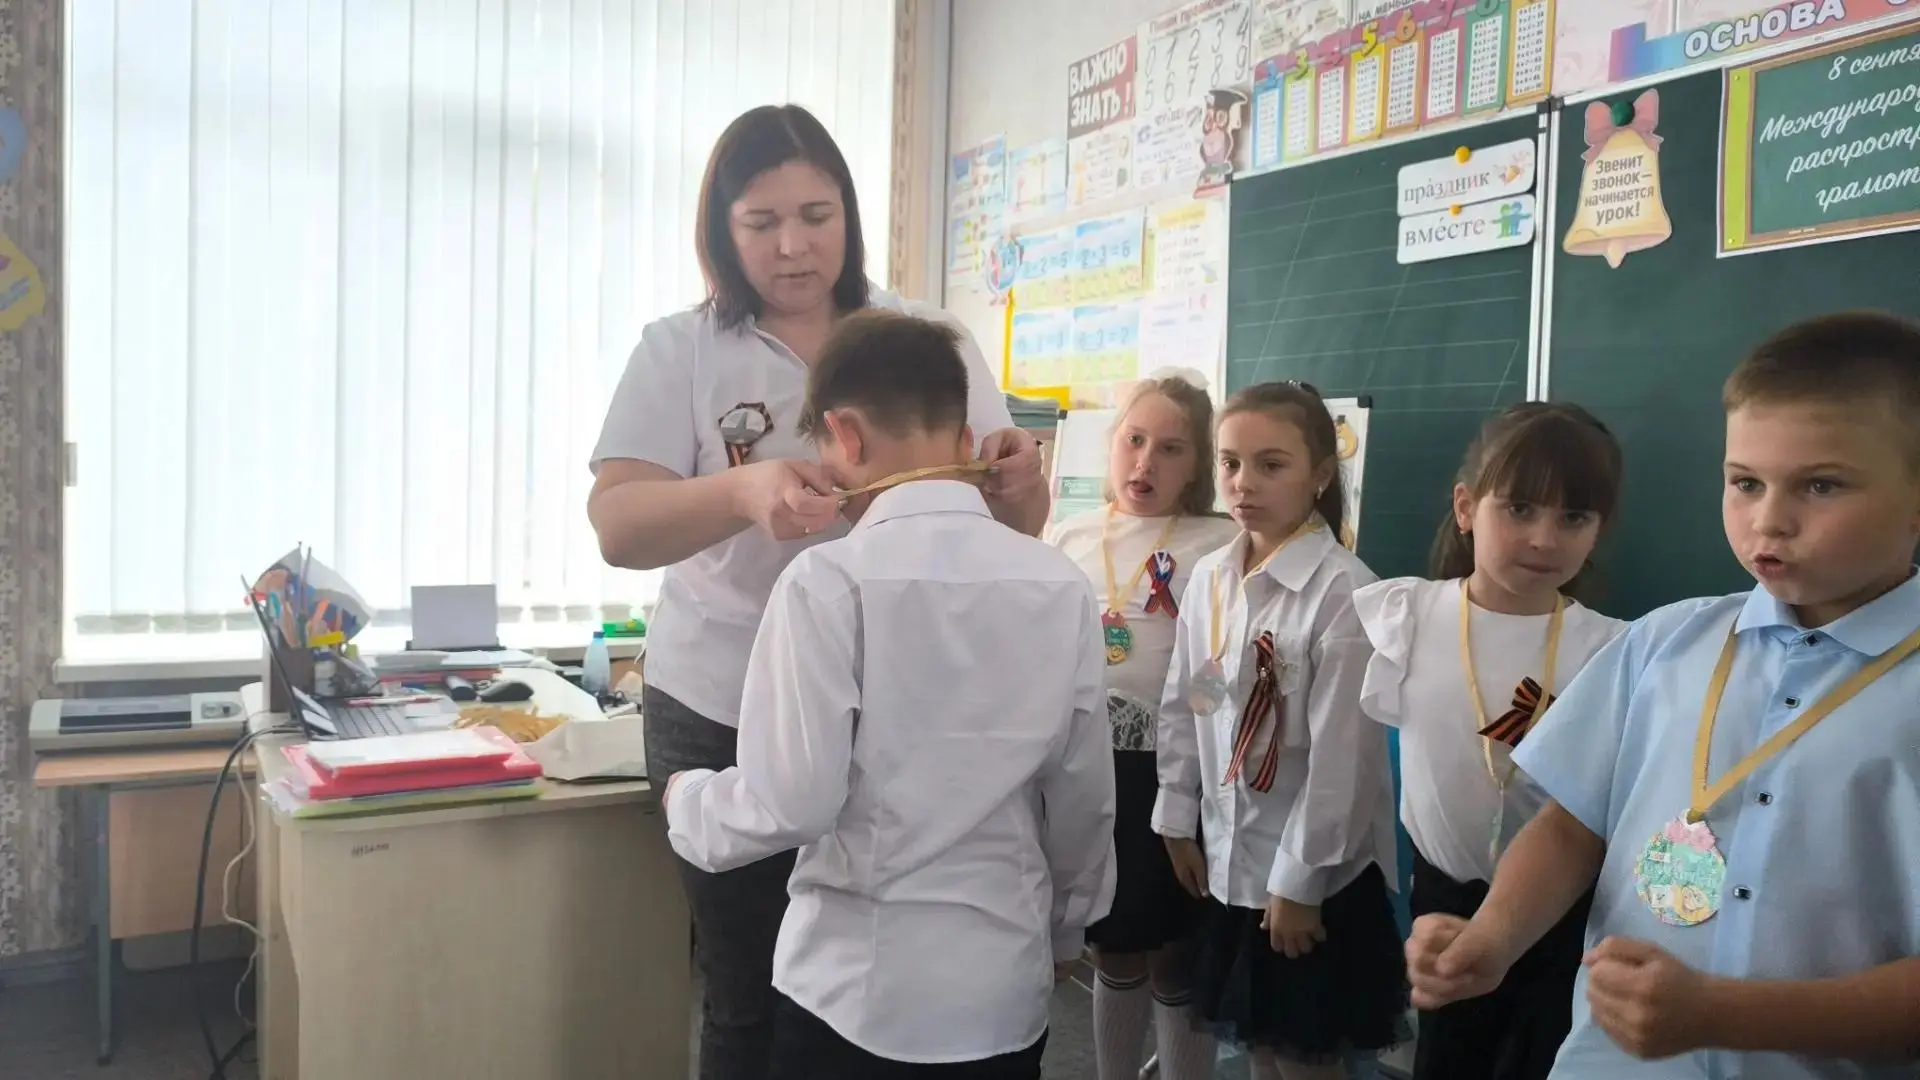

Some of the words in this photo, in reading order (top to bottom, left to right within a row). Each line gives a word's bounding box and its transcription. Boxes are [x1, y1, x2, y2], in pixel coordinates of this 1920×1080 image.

[1361, 19, 1379, 57] 5
[1396, 8, 1418, 43] 6
[1685, 0, 1847, 59] ОСНОВА
[1069, 42, 1128, 98] ВАЖНО
[1828, 55, 1847, 80] 8
[1596, 155, 1643, 174] Звенит
[1585, 186, 1654, 207] начинается
[1596, 201, 1640, 226] урок!
